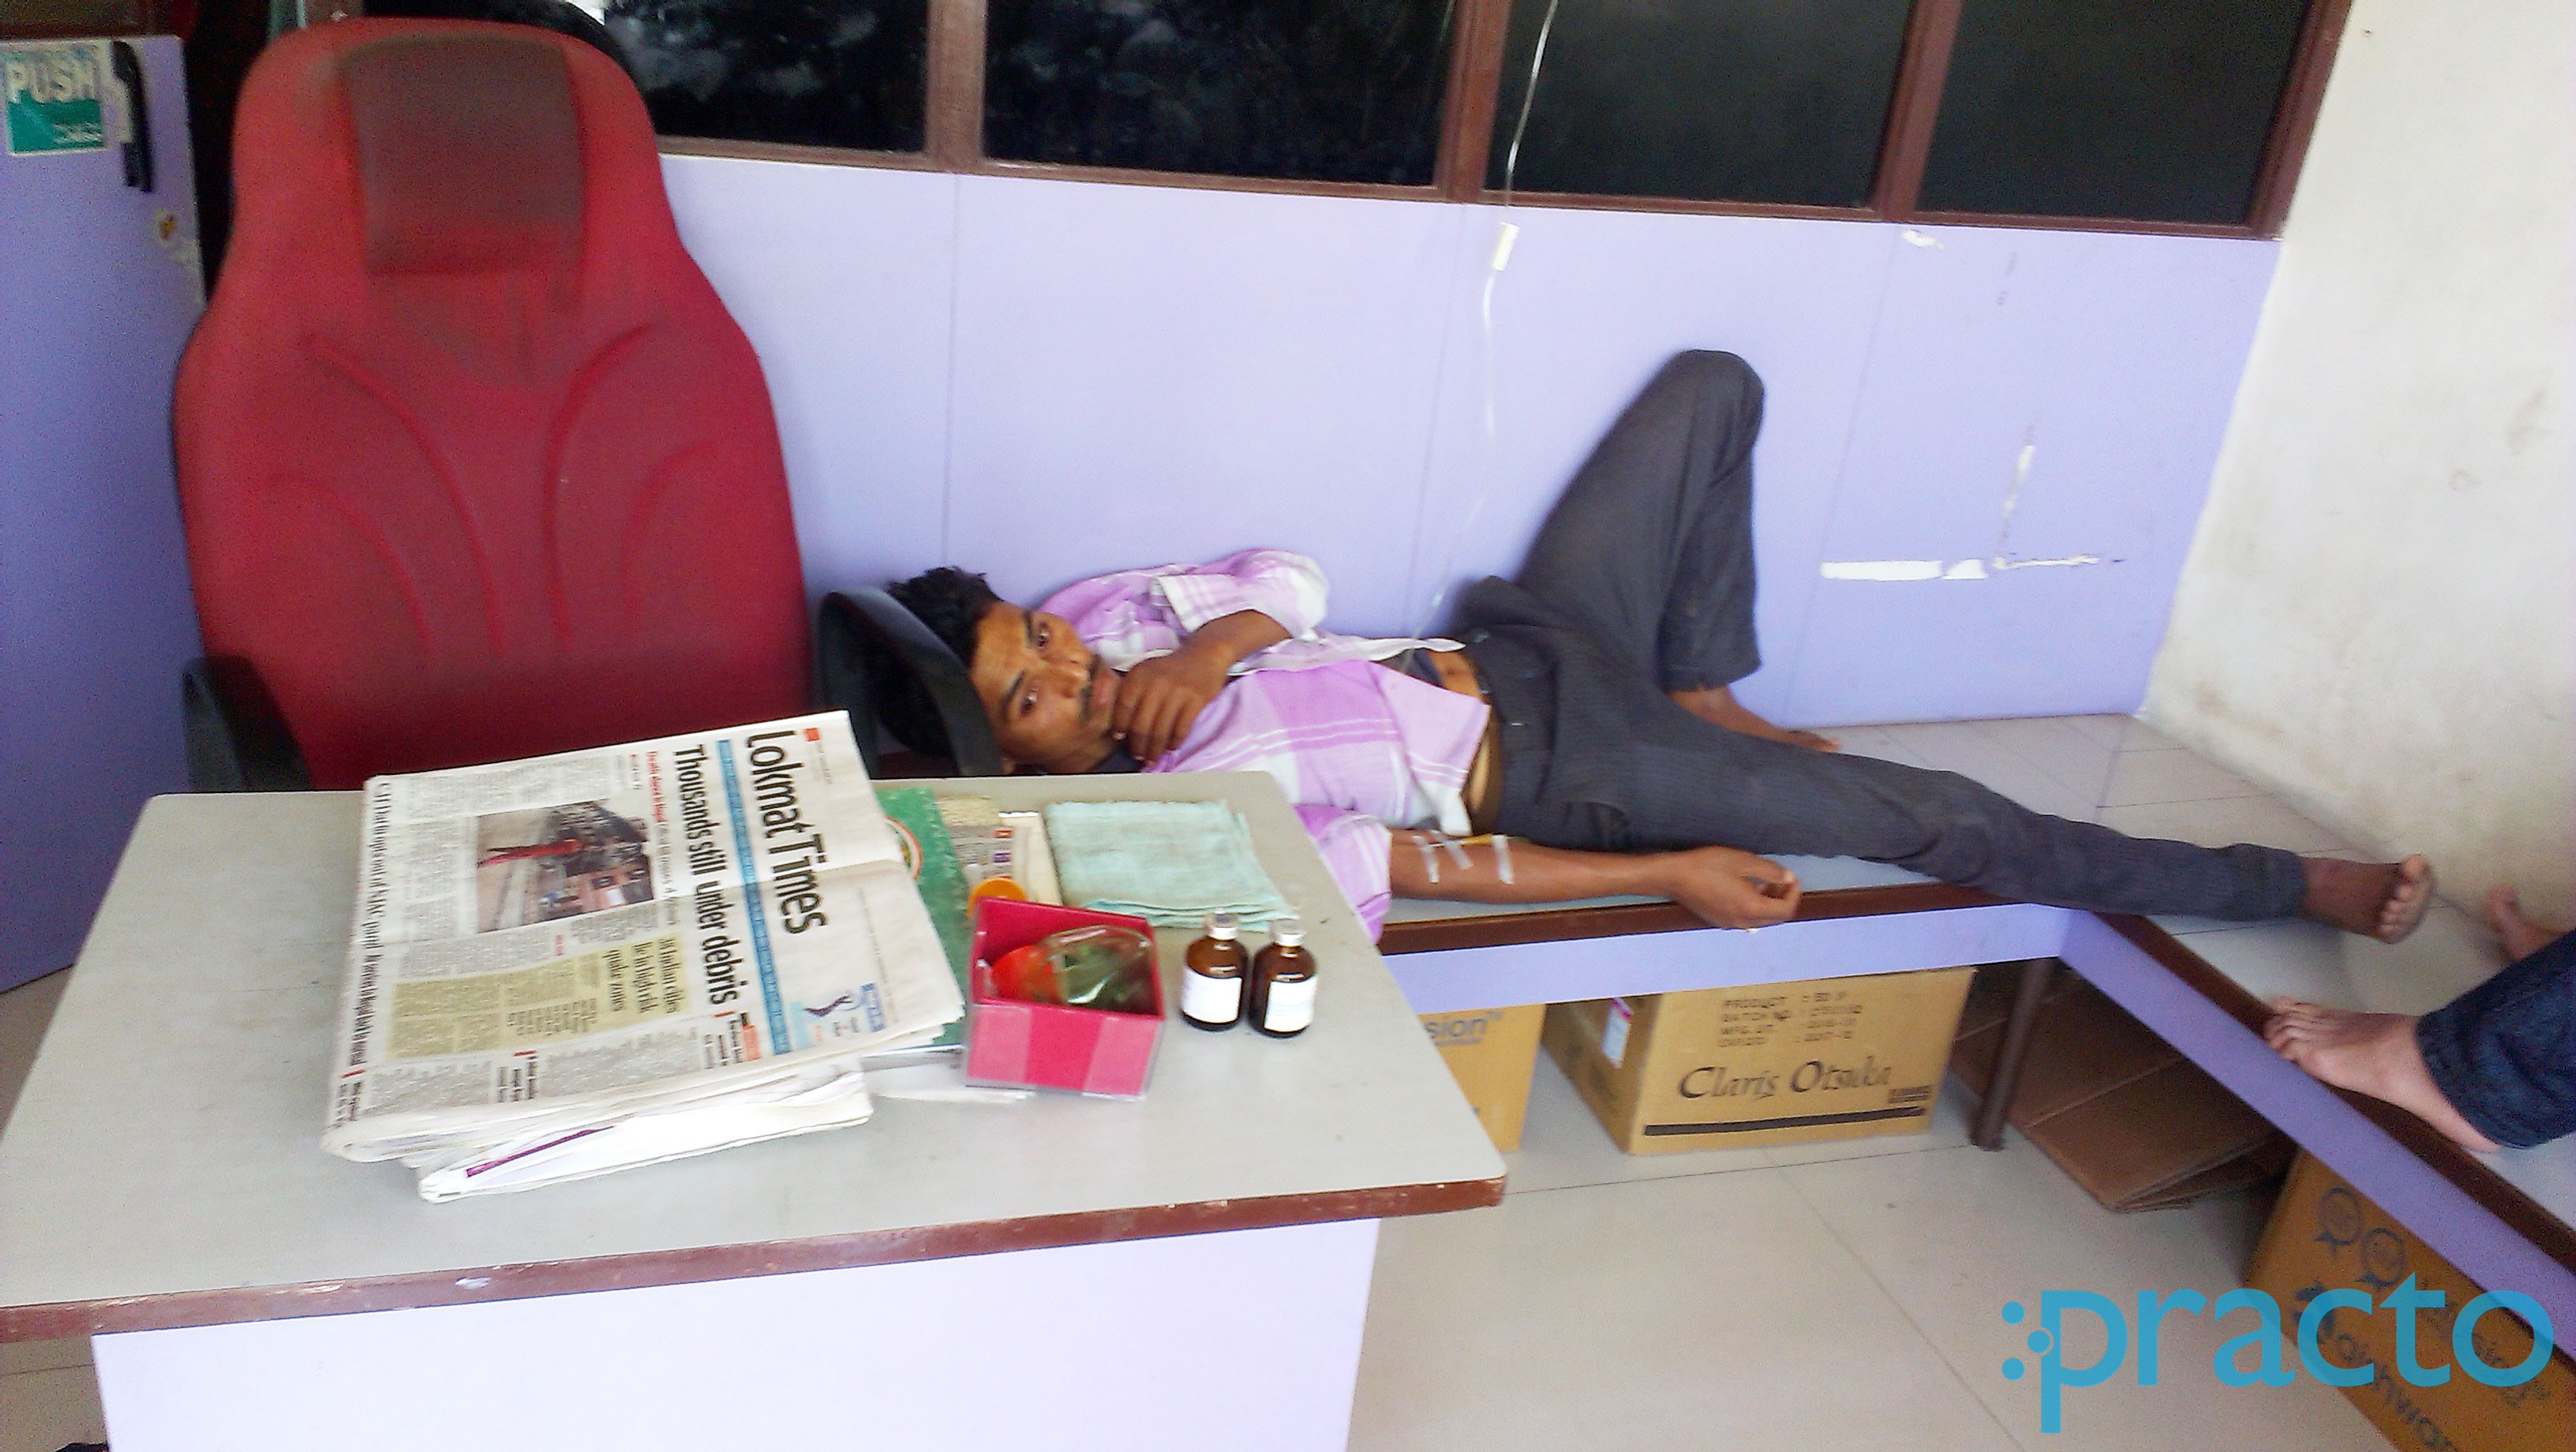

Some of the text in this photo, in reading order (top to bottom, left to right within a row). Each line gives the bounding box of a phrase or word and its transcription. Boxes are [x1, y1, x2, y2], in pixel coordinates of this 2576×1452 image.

[6, 59, 96, 103] PUSH
[674, 744, 721, 840] Thousands
[746, 729, 810, 840] Lokmat
[689, 838, 728, 877] still
[768, 833, 828, 934] Times
[695, 881, 734, 930] under
[602, 949, 630, 979] quake
[630, 966, 658, 992] high
[634, 955, 654, 967] in
[659, 950, 682, 983] Indian
[700, 937, 749, 1005] debris
[662, 985, 686, 1013] cities
[1724, 996, 1788, 1009] PRODUCT
[1678, 1055, 1892, 1100] Claris Otsuka
